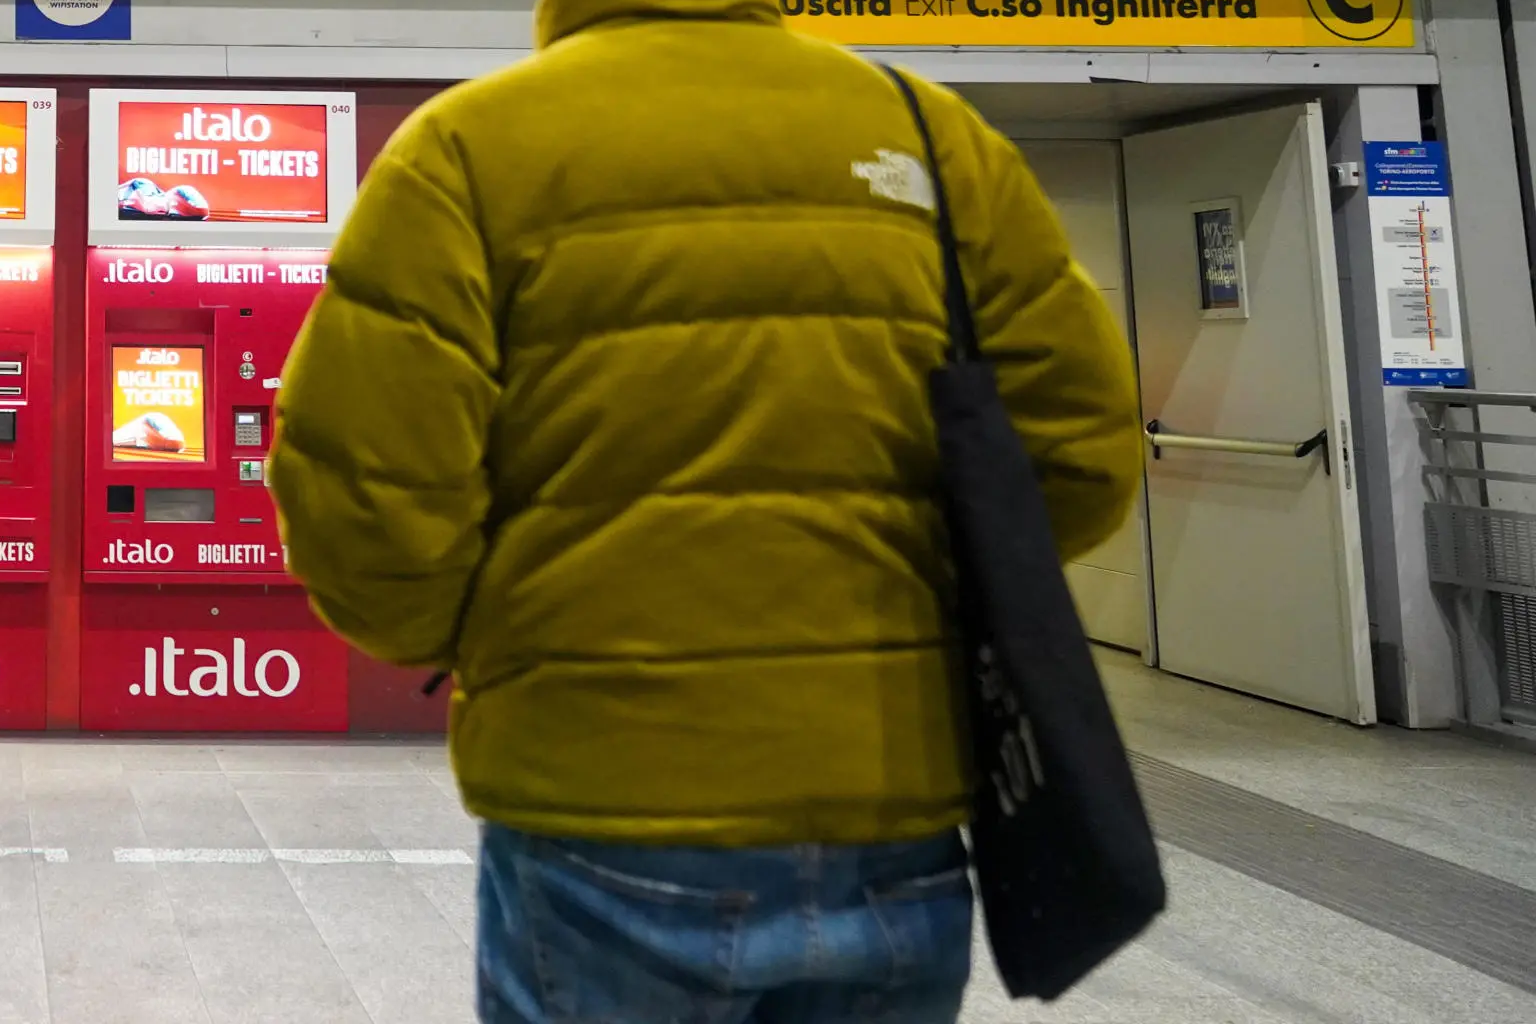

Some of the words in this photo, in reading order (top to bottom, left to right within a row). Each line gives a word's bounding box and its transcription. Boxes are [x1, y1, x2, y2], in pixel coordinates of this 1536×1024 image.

[32, 100, 52, 110] 039
[331, 105, 350, 114] 040
[126, 147, 218, 175] BIGLIETTI
[238, 149, 318, 177] TICKETS
[197, 264, 264, 283] BIGLIETTI
[117, 371, 199, 388] BIGLIETTI
[124, 388, 194, 406] TICKETS
[198, 544, 265, 564] BIGLIETTI
